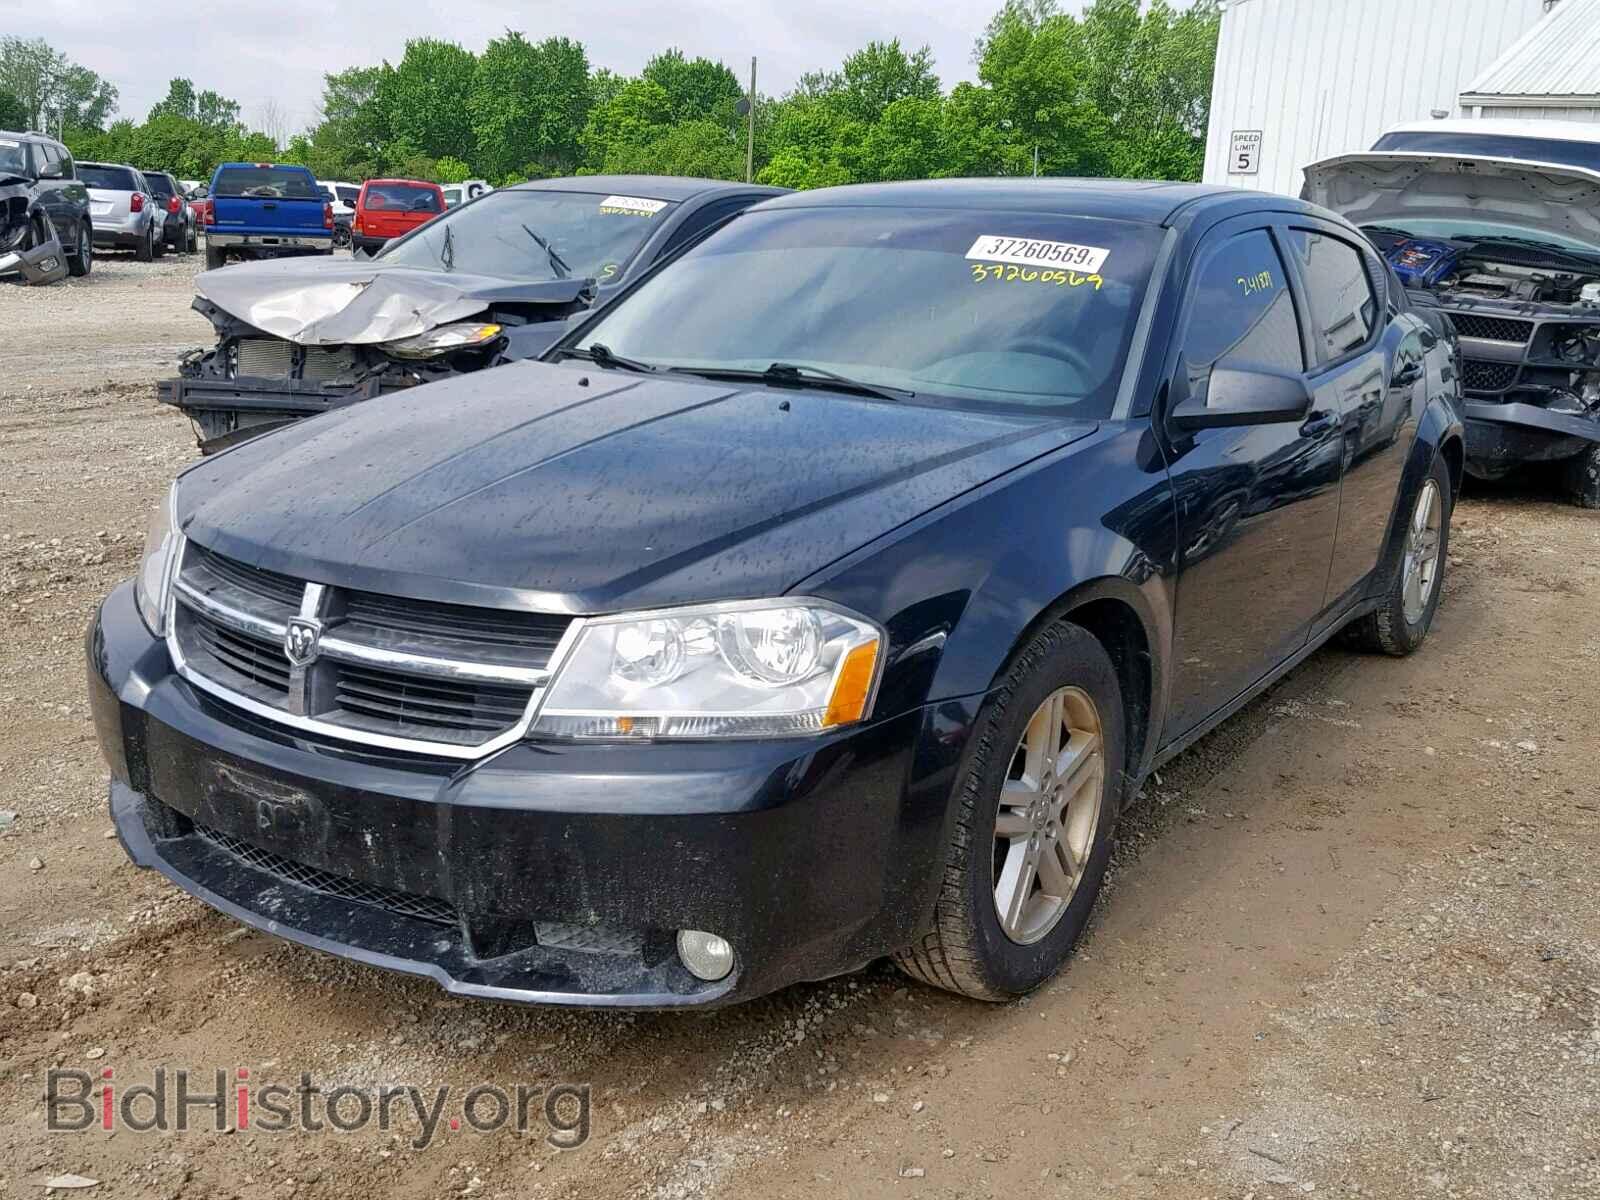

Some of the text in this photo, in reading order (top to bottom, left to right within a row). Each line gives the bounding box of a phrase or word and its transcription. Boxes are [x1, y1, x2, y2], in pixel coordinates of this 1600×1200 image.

[1233, 134, 1260, 142] SPEED
[1238, 153, 1250, 169] 5
[987, 238, 1090, 266] 37260569
[969, 263, 1104, 290] 37260569
